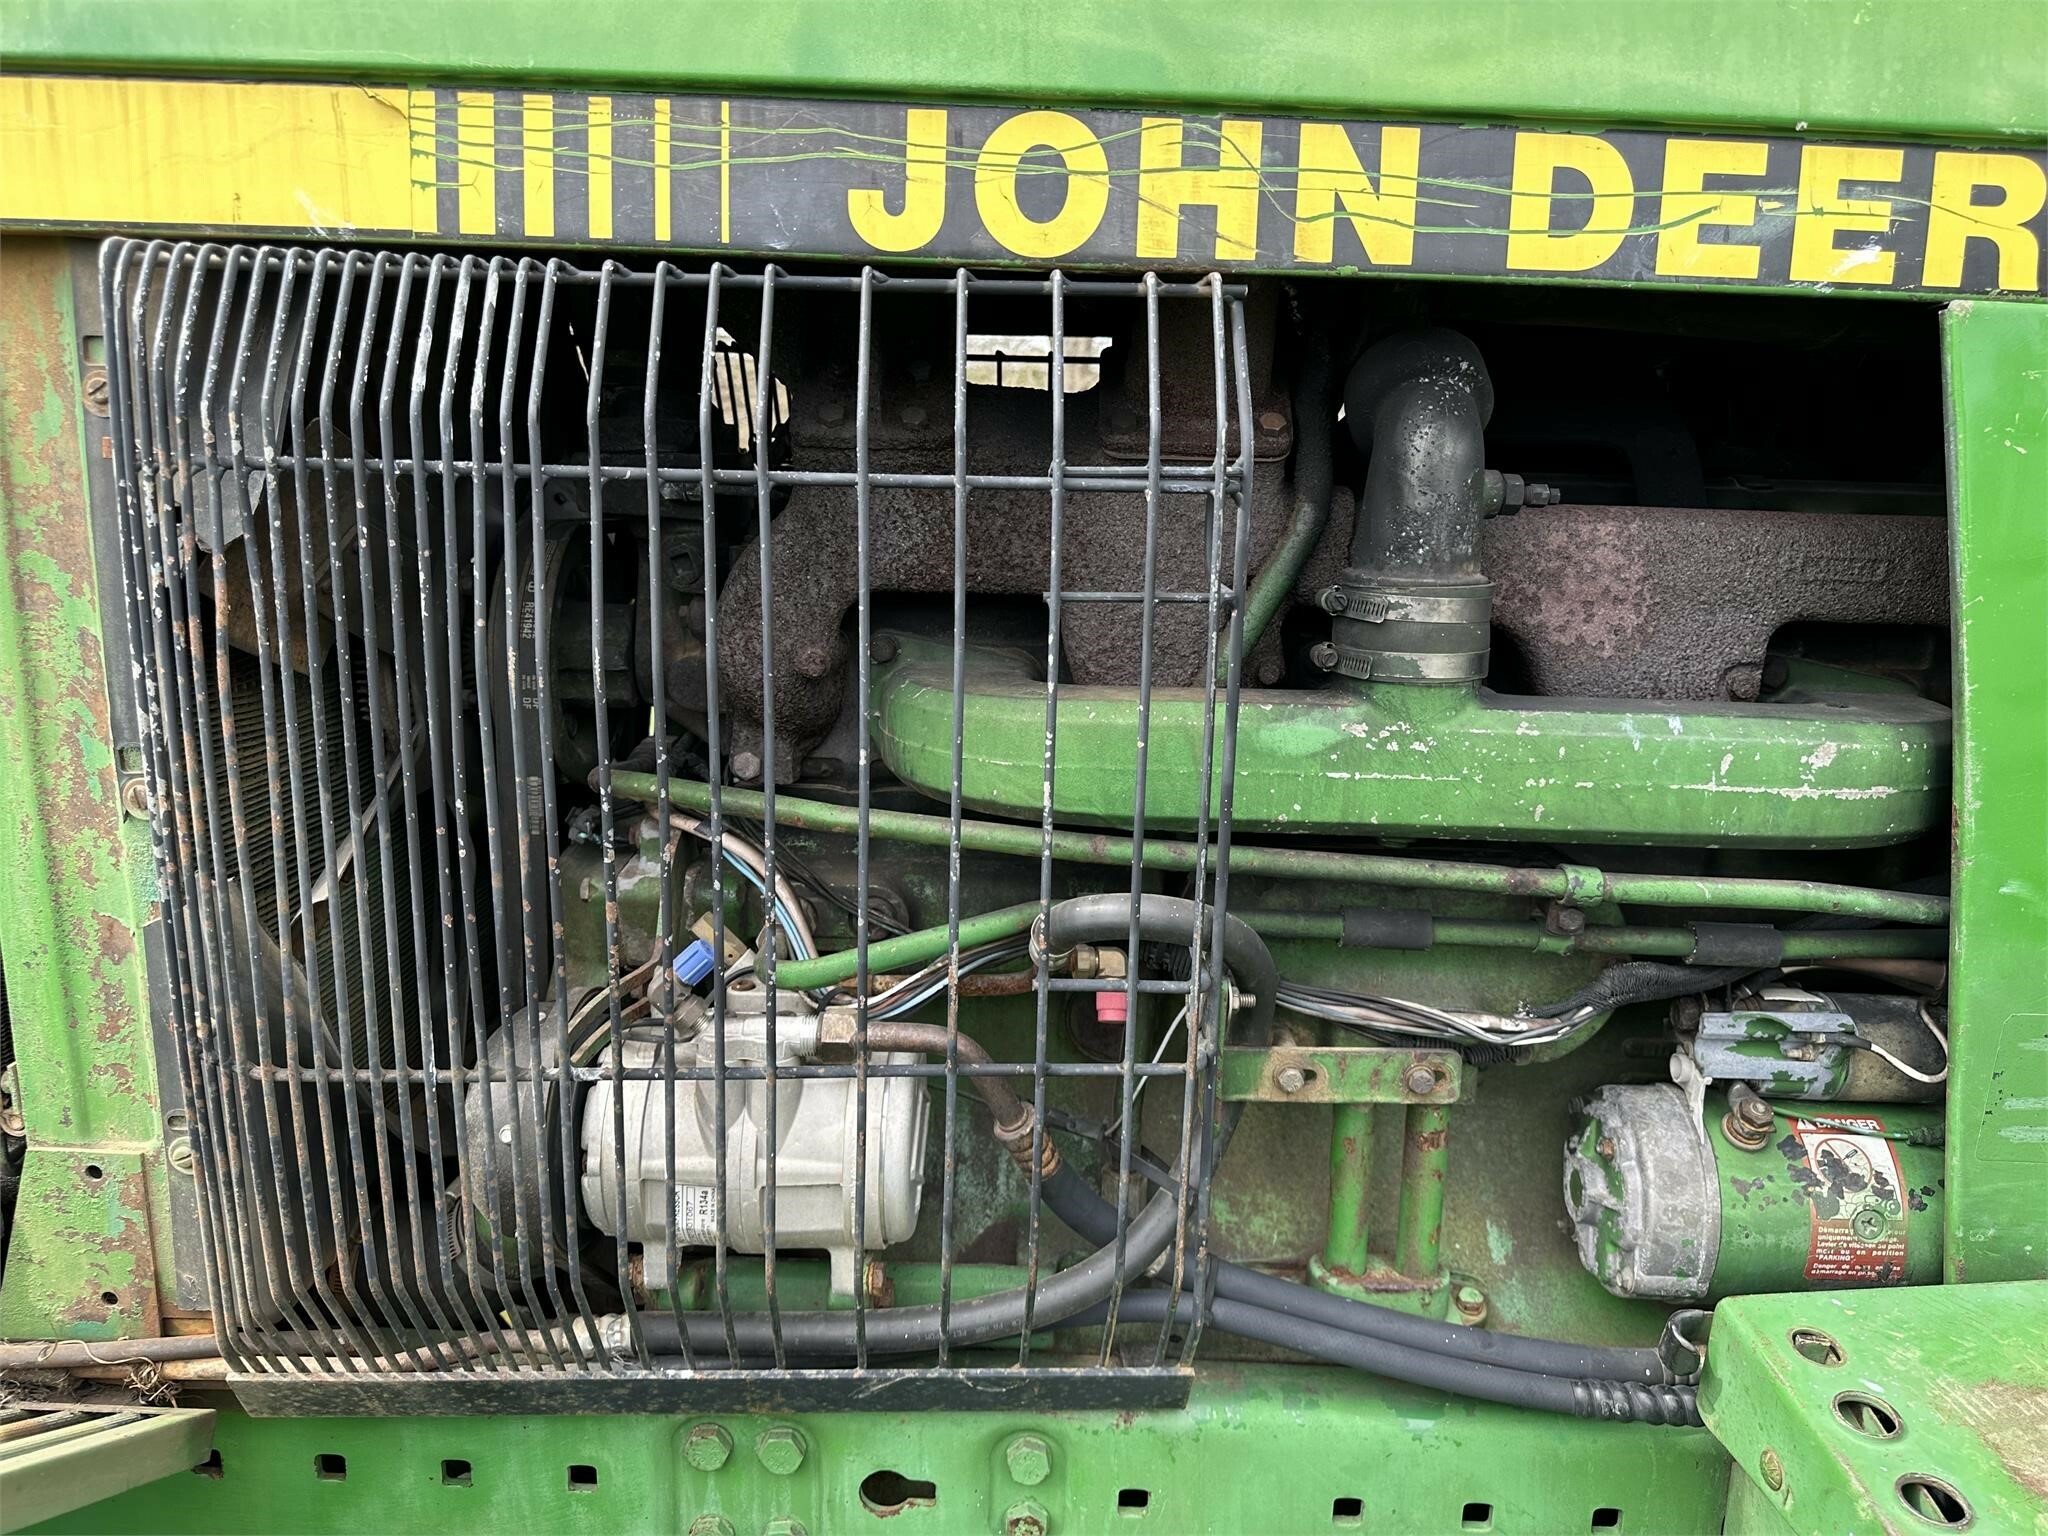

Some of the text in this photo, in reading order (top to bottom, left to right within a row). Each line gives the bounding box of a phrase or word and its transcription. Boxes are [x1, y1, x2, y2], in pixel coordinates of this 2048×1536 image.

[847, 109, 1420, 265] JOHN
[1818, 1227, 1854, 1235] Démarra
[1872, 1249, 1904, 1257] position
